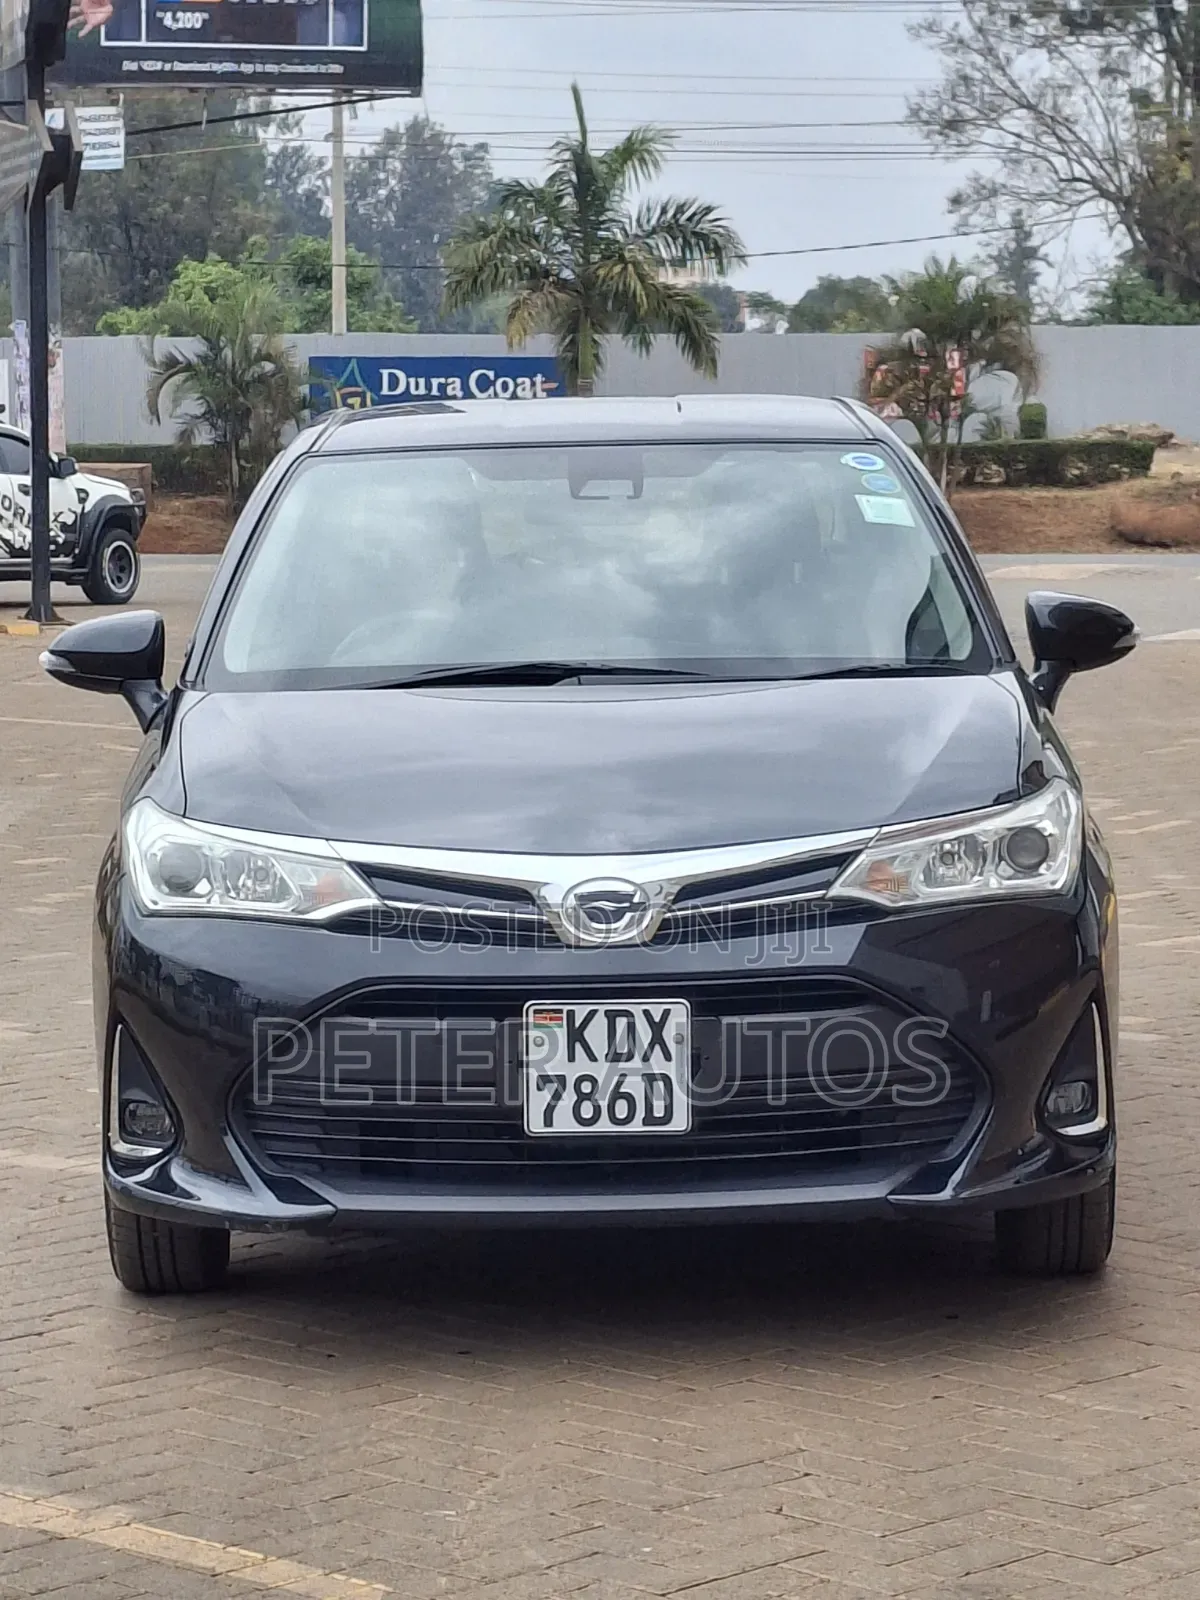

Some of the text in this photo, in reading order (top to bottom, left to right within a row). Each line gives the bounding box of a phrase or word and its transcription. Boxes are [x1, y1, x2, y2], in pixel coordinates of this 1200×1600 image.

[379, 368, 547, 399] Dura Coat
[566, 1008, 673, 1063] KDX
[536, 1072, 674, 1128] 786D
